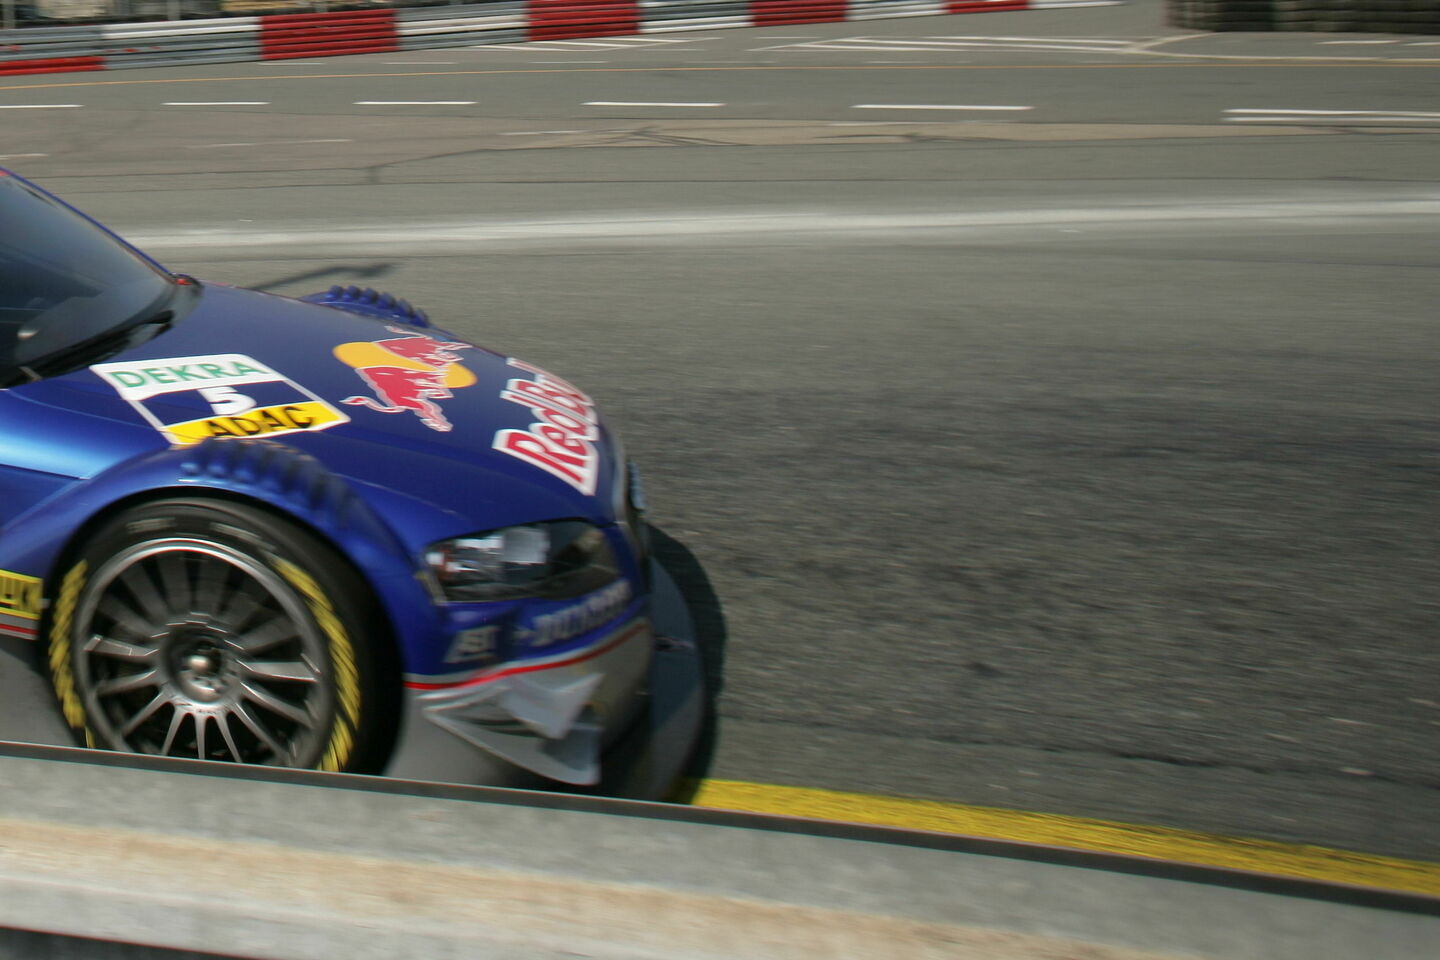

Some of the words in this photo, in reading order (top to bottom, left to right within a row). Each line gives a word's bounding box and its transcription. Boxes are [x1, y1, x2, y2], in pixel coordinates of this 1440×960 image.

[108, 360, 270, 389] DEKRA
[196, 385, 258, 416] 5
[205, 405, 314, 438] ADAC
